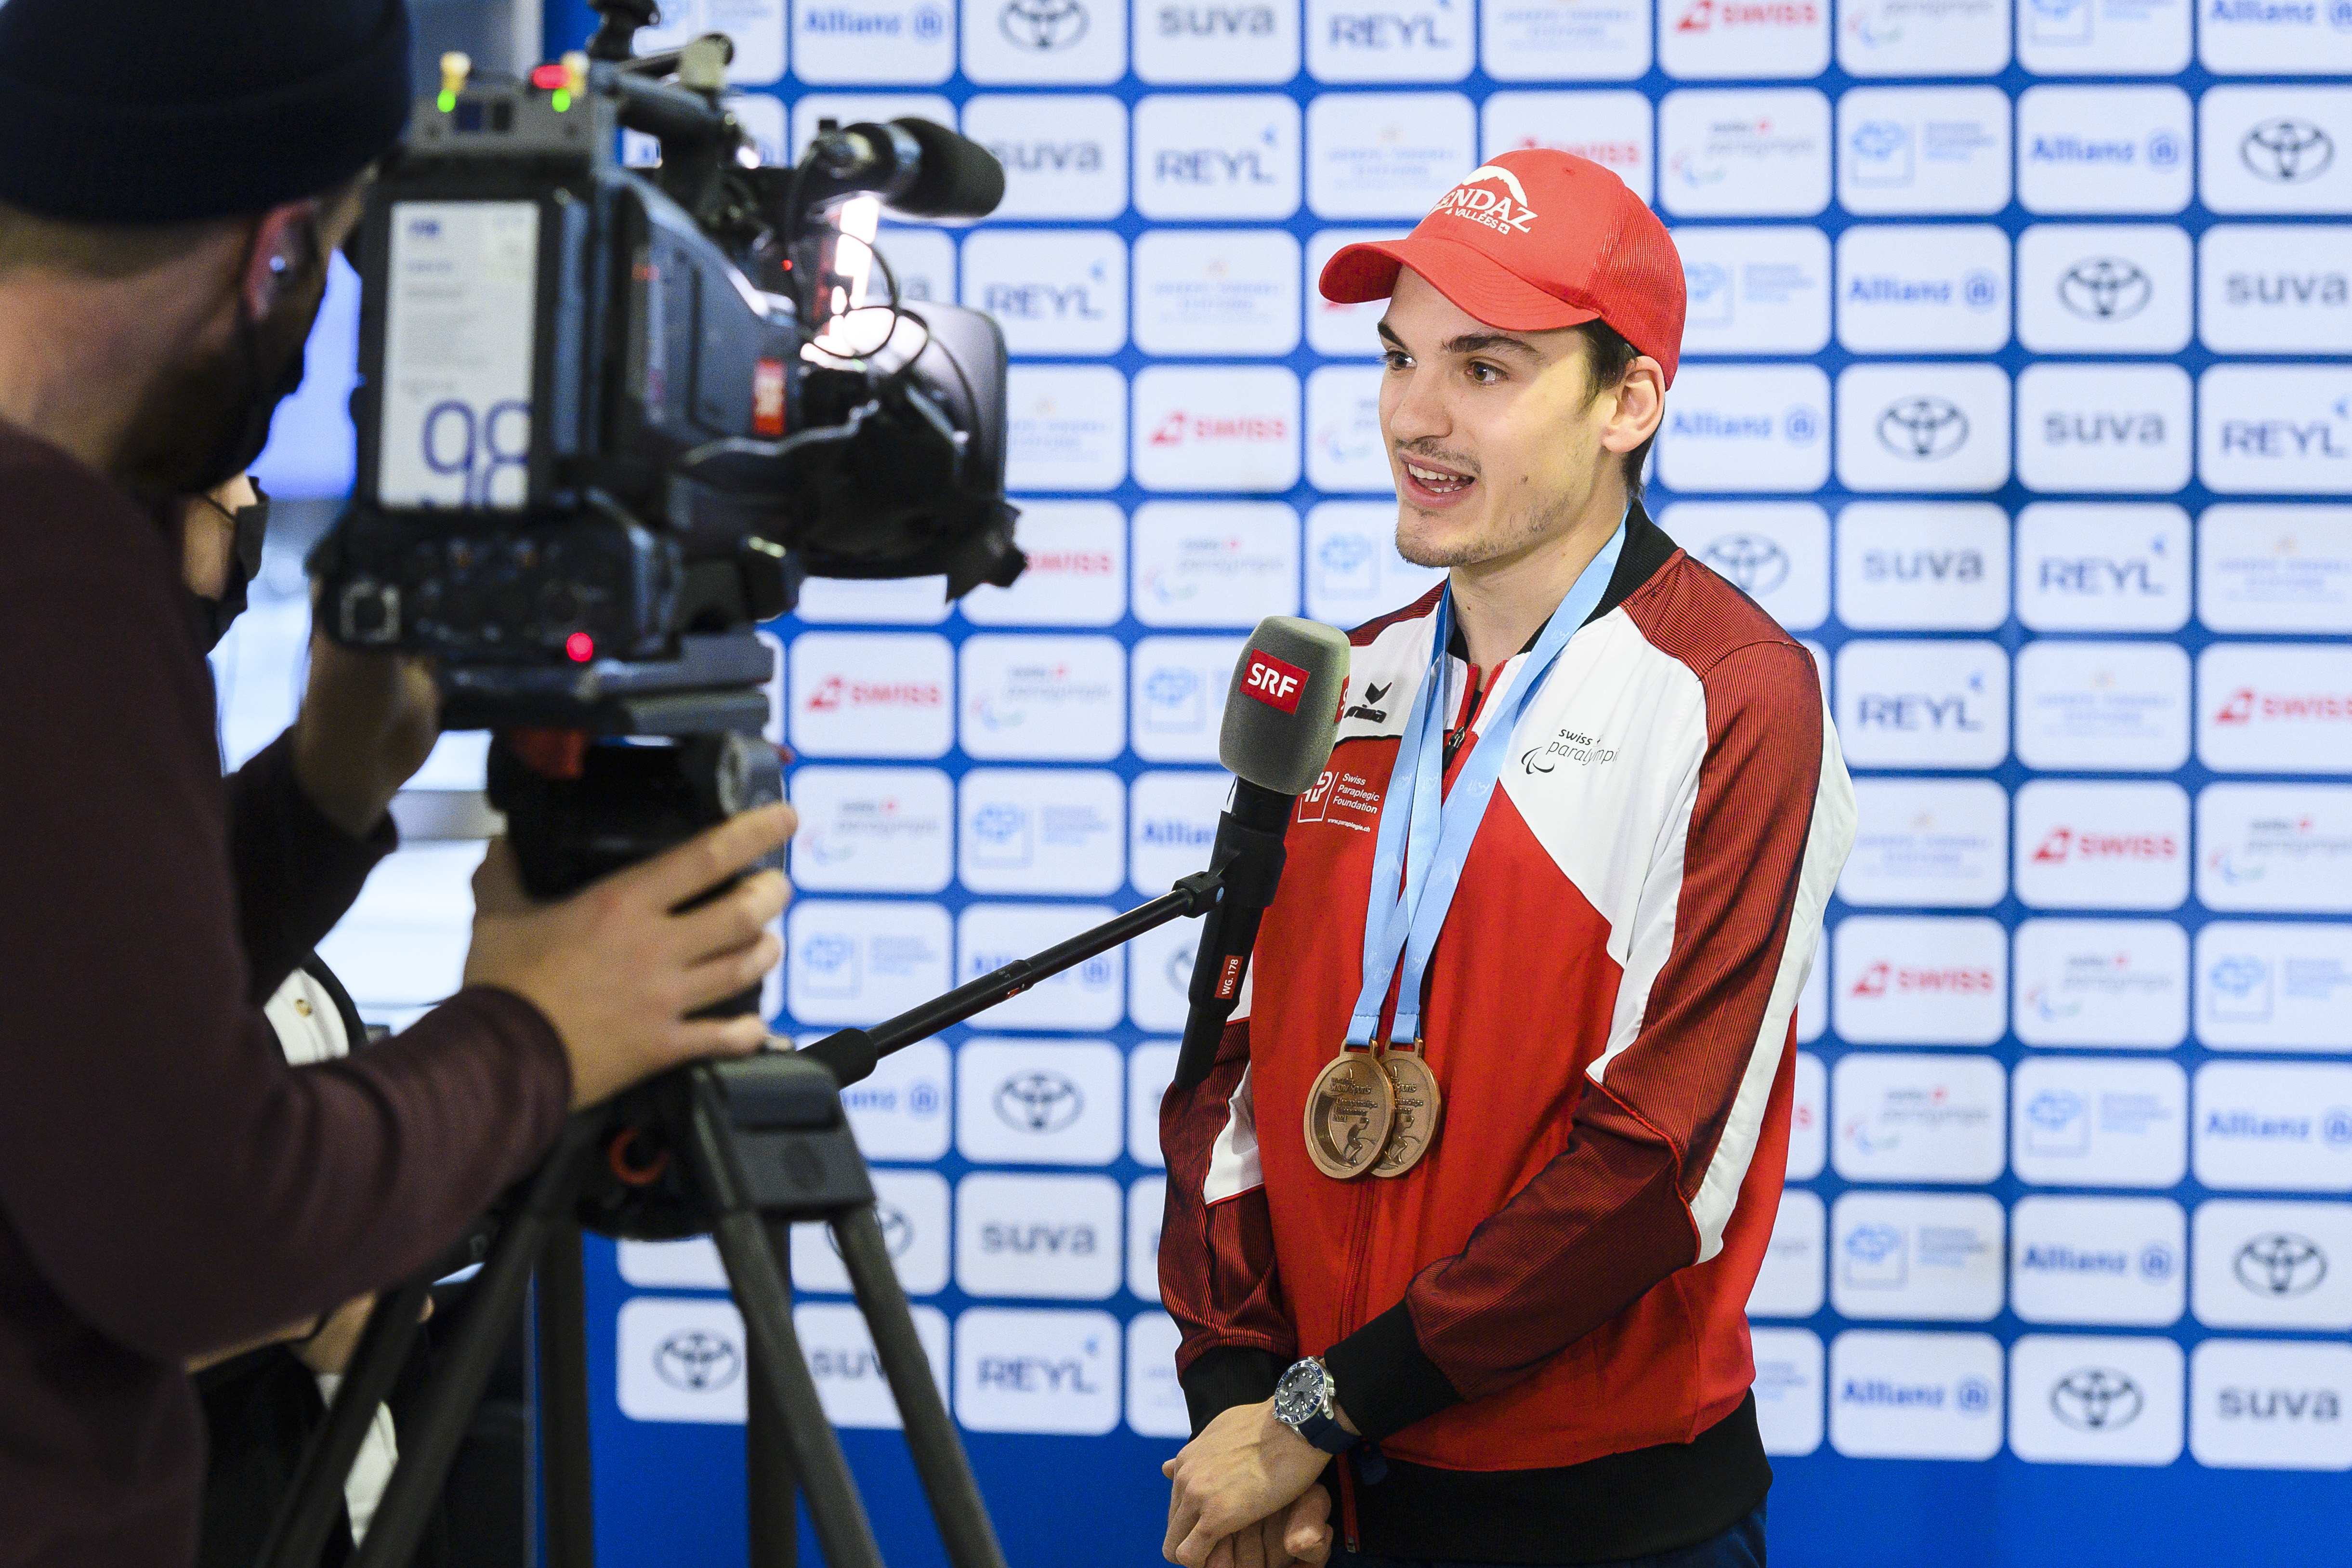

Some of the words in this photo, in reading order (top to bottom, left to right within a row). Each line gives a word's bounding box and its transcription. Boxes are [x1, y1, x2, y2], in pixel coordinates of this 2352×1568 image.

[1157, 5, 1276, 37] suva
[1328, 14, 1449, 49] REYL
[2029, 136, 2136, 163] Allianz
[1155, 148, 1274, 184] REYL
[1425, 188, 1538, 233] ENDAZ
[1455, 207, 1499, 229] VALLÉES
[985, 285, 1103, 321] REYL
[1847, 277, 1953, 304] Allianz
[2224, 273, 2350, 306] suva
[2043, 413, 2167, 445] suva
[2220, 422, 2347, 457] REYL
[1863, 549, 1985, 583] suva
[2037, 557, 2166, 594] REYL
[1247, 662, 1298, 698] SRF
[1857, 694, 1982, 731] REYL
[1558, 729, 1593, 746] swiss
[1337, 784, 1380, 802] Paraplegic
[1342, 773, 1366, 786] Swiss
[1332, 796, 1378, 814] Foundation
[1327, 818, 1371, 832] www.paraplegie.ch
[1227, 959, 1238, 975] 178
[1222, 977, 1234, 995] WG.
[2205, 1111, 2311, 1140] Allianz
[981, 1223, 1098, 1256] suva
[2022, 1245, 2127, 1273] Allianz
[977, 1357, 1098, 1394] REYL
[1840, 1379, 1945, 1408] Allianz
[2218, 1388, 2341, 1421] suva
